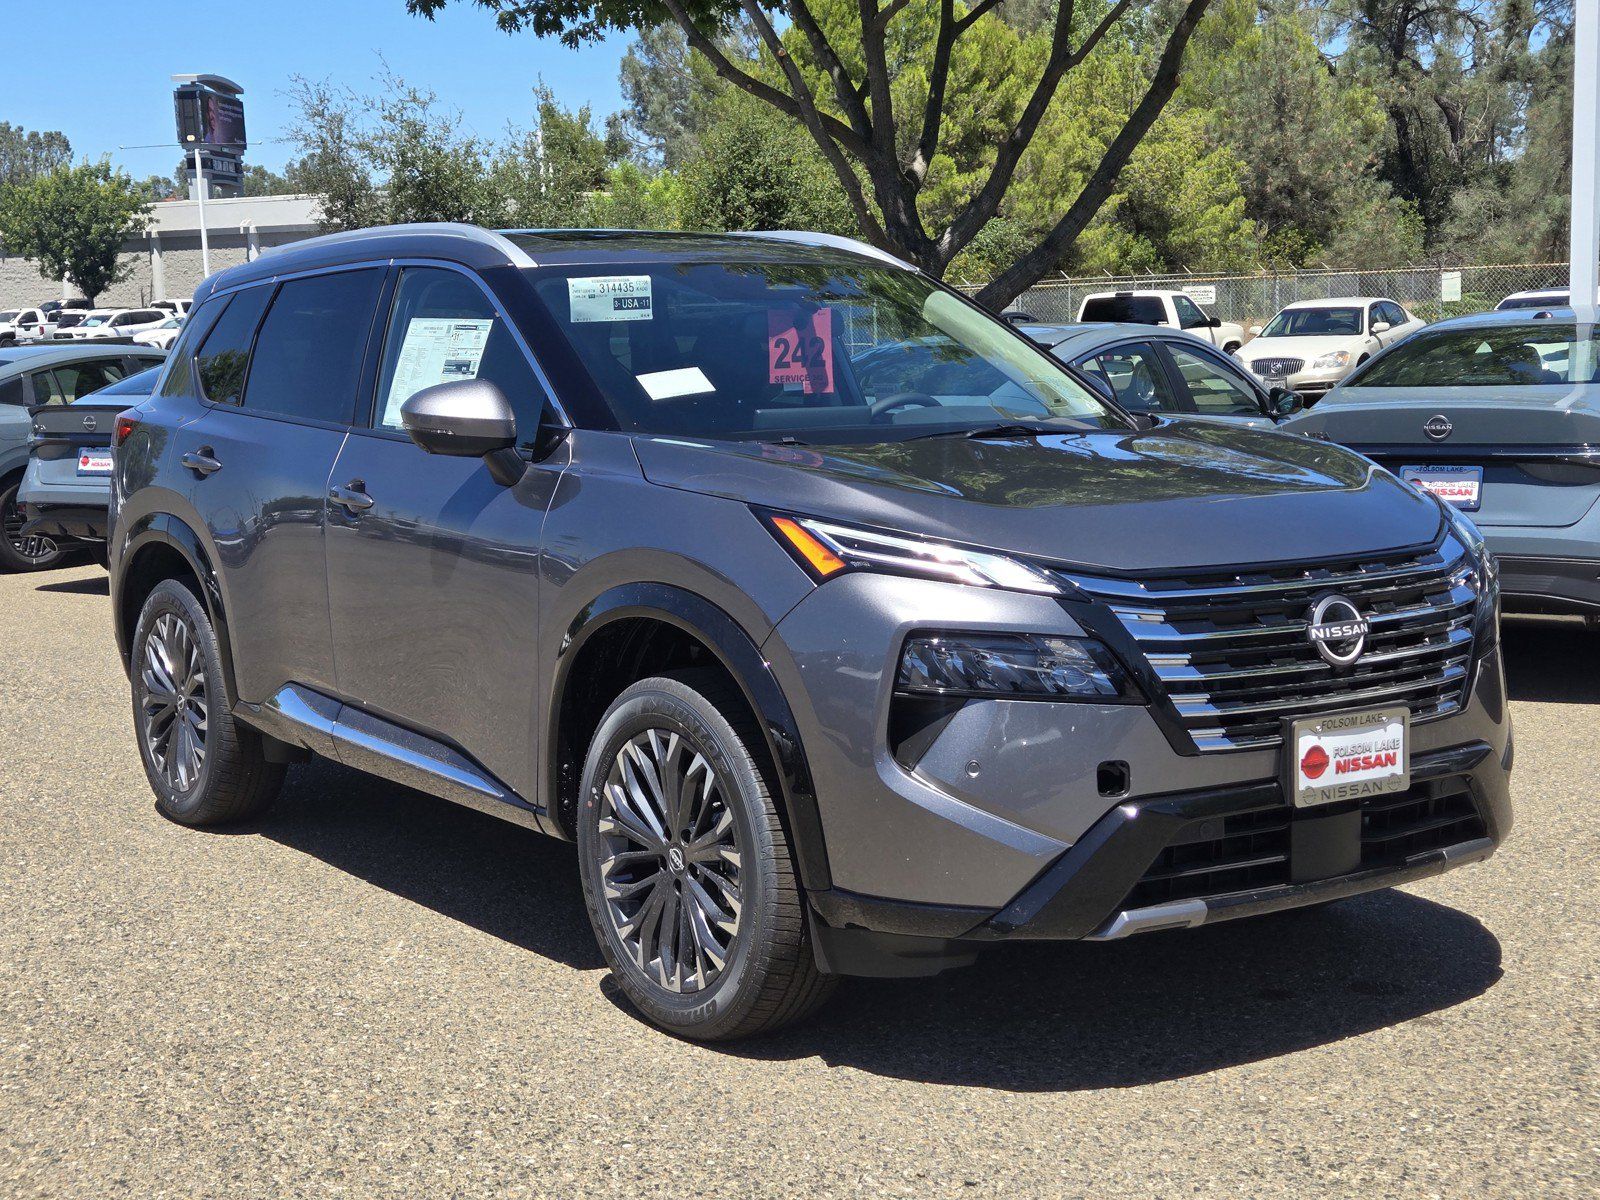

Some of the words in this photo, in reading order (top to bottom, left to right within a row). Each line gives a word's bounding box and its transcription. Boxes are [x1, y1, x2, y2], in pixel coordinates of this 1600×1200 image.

[599, 282, 635, 294] 314435
[622, 298, 639, 308] USA
[774, 336, 826, 370] 242
[774, 374, 811, 384] SERVICE
[1310, 622, 1369, 639] NISSAN
[1321, 717, 1358, 730] FOLSOM
[1360, 713, 1383, 725] LAKE
[1332, 742, 1372, 759] FOLSOM
[1374, 738, 1400, 752] LAKE
[1335, 752, 1397, 775] NISSAN
[1321, 782, 1383, 801] NISSAN
